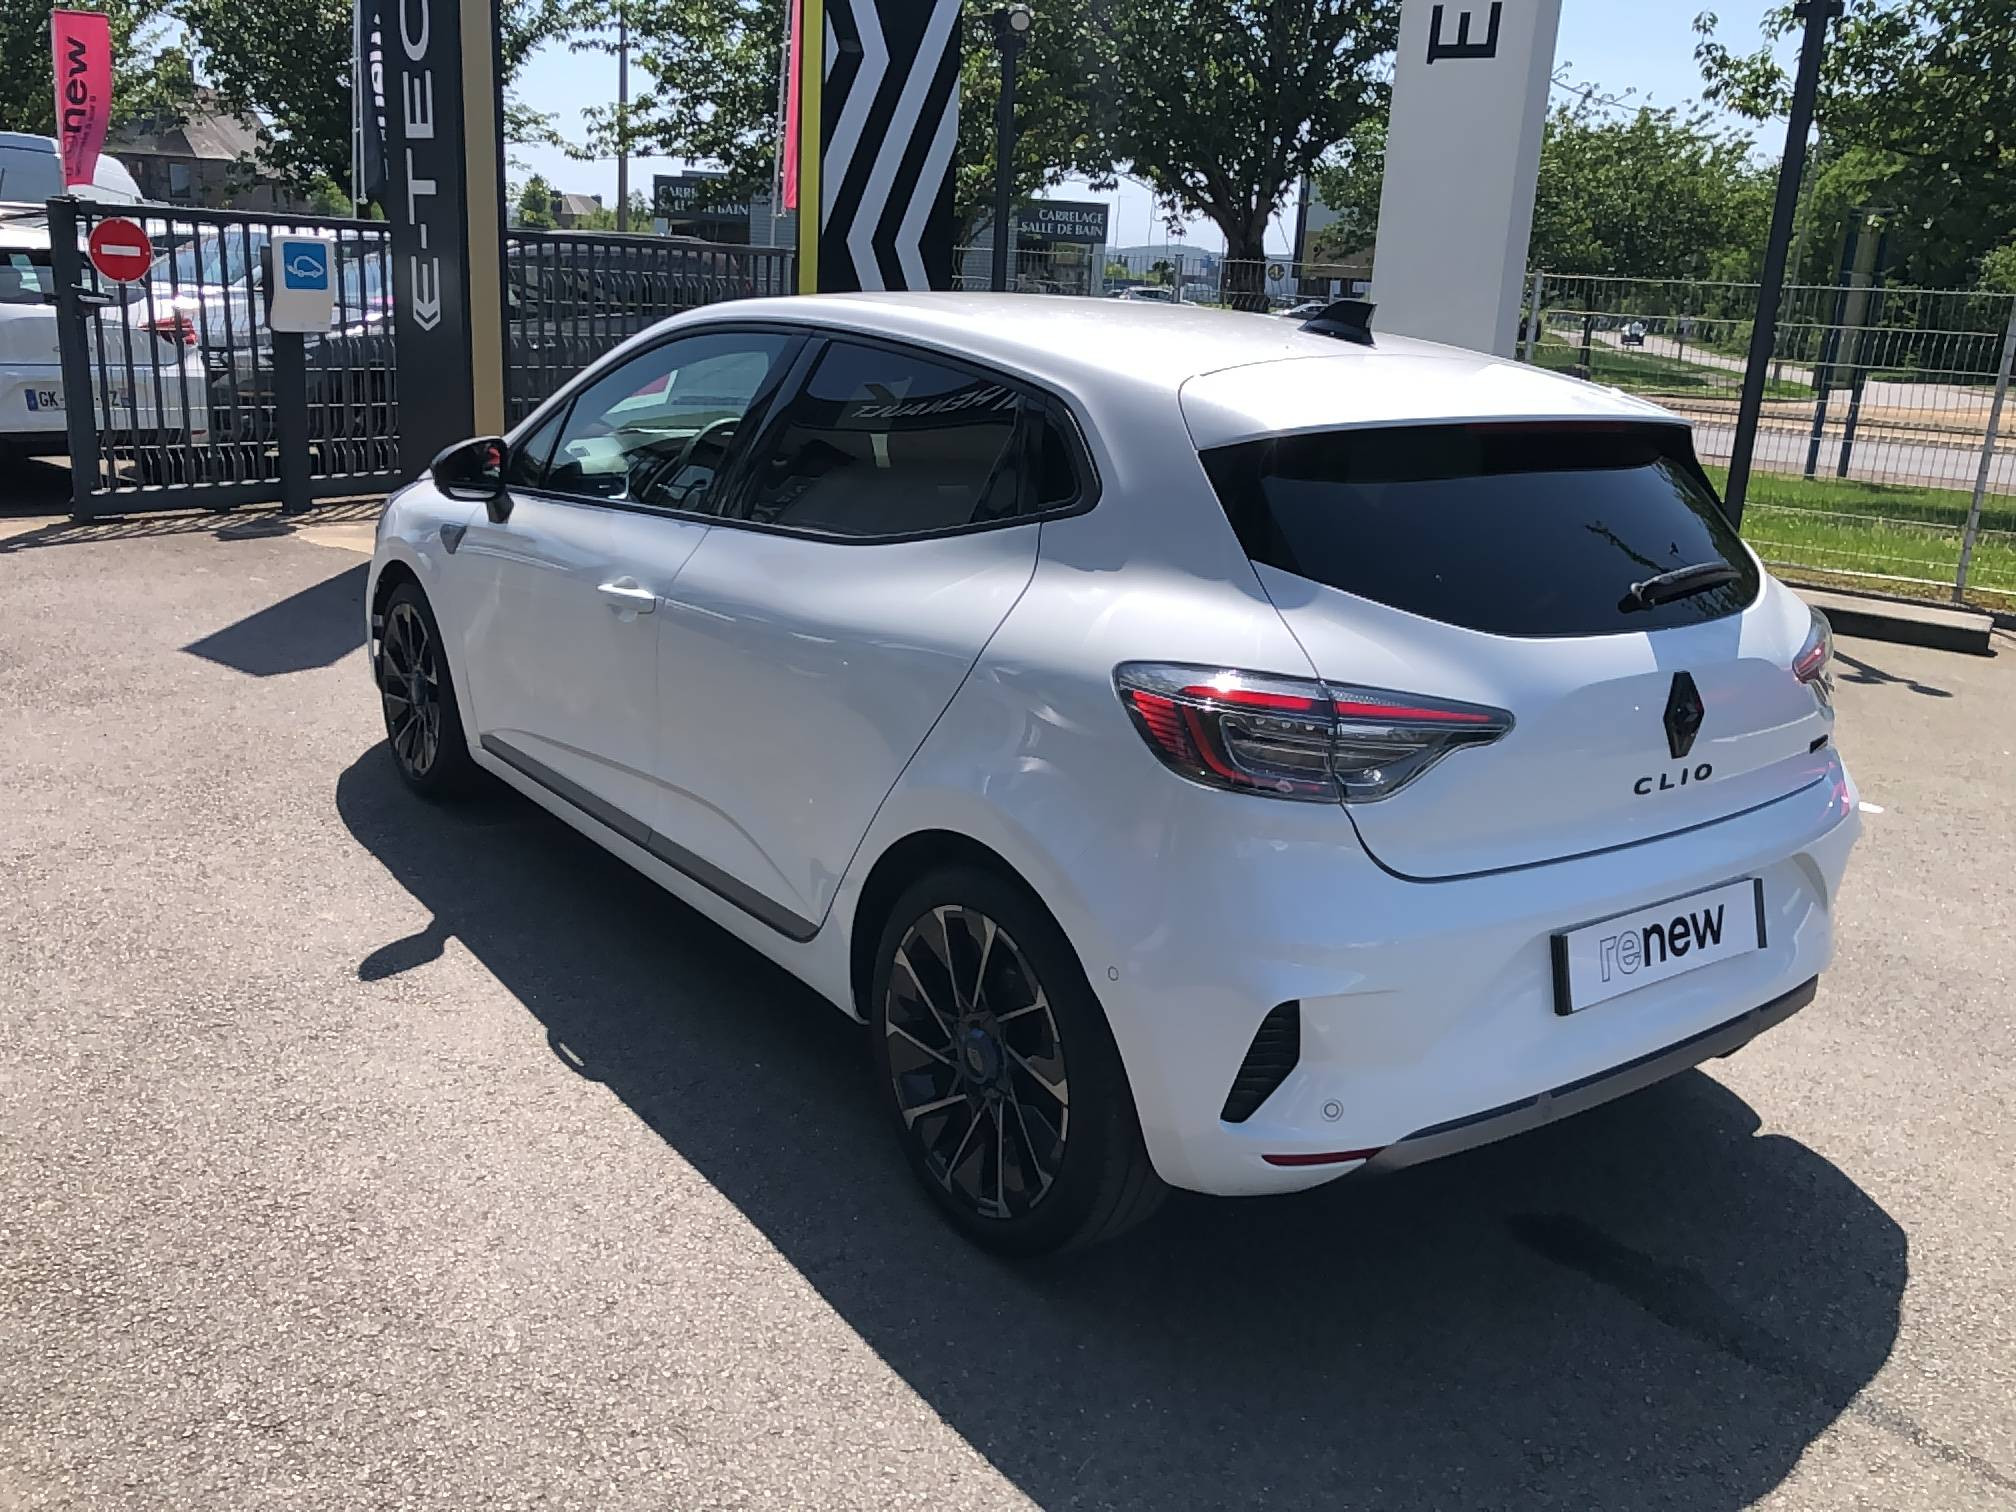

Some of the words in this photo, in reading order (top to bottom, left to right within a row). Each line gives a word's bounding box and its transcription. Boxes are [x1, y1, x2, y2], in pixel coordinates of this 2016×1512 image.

[1039, 209, 1104, 224] CARRELAGE
[1021, 221, 1053, 234] SALLE
[1057, 223, 1072, 235] DE
[1075, 224, 1103, 237] BAIN
[1633, 763, 1713, 796] CLIO
[1600, 904, 1725, 983] renew
